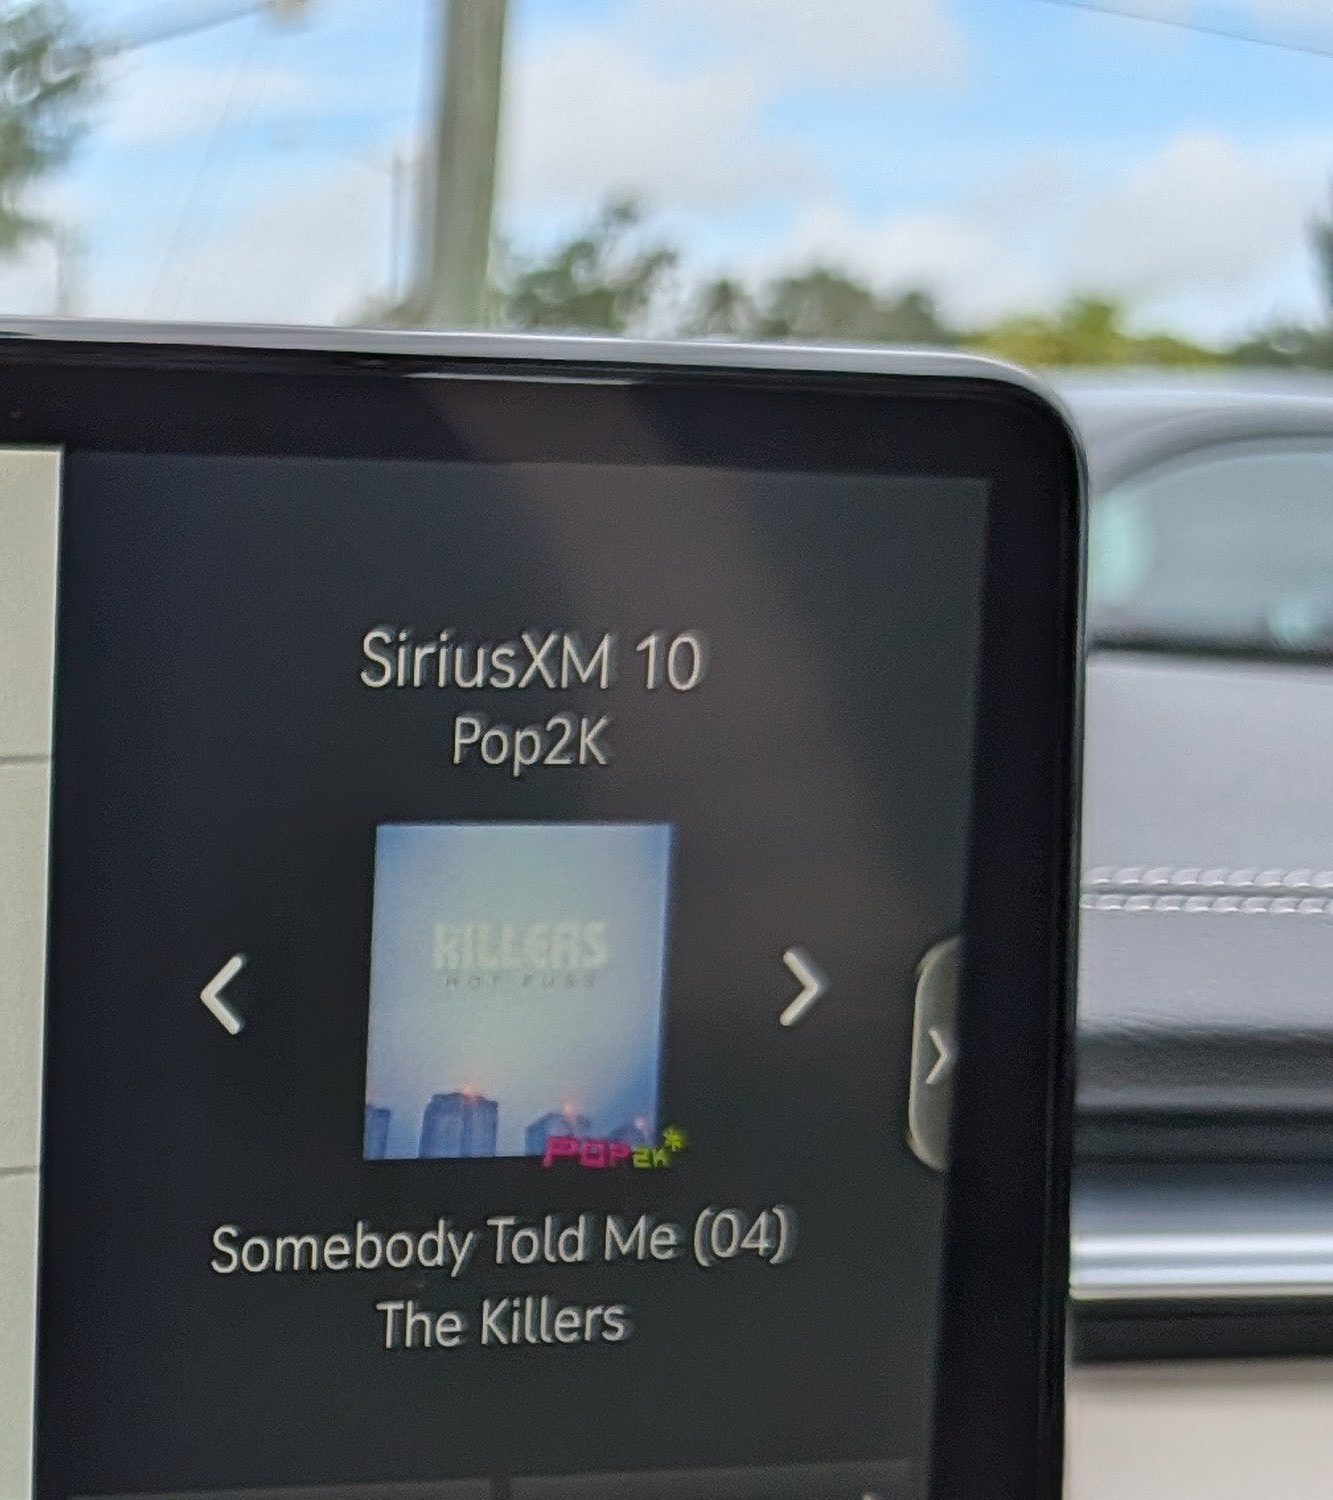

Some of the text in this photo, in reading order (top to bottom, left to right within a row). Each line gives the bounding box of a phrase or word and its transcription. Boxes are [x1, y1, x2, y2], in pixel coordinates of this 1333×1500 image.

[359, 629, 703, 692] SiriusXM 10
[452, 716, 611, 778] Pop2K
[434, 920, 609, 970] KILLERS
[210, 1204, 791, 1277] Somebody Told Me (04)
[376, 1296, 630, 1349] The Killers
